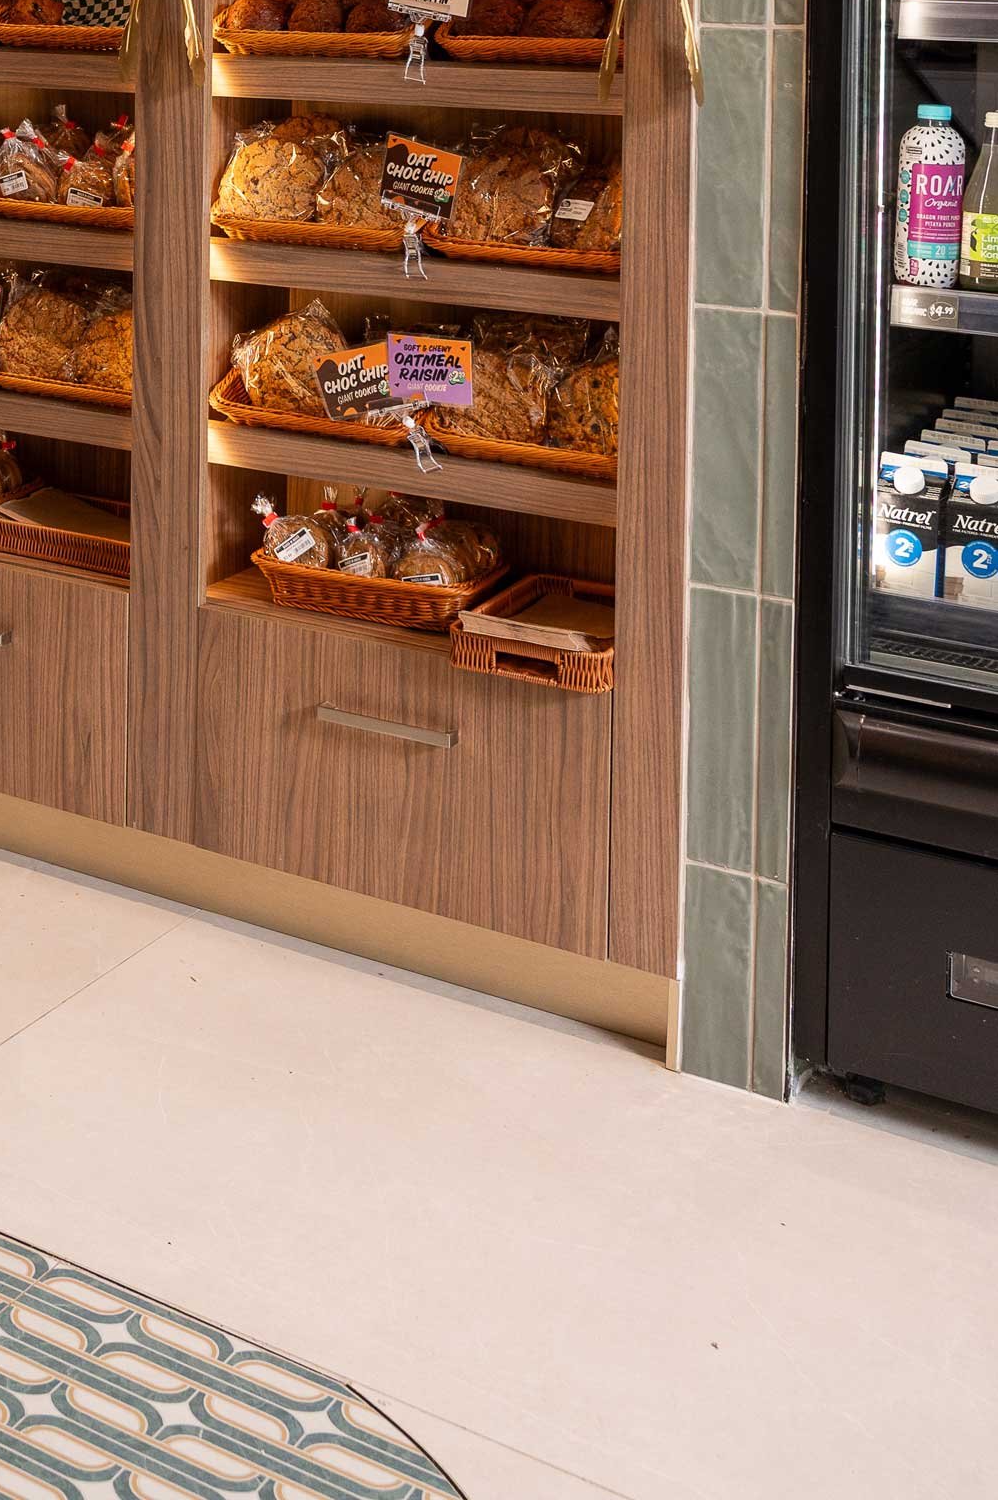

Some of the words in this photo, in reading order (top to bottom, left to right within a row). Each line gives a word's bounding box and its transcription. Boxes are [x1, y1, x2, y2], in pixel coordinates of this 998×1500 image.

[406, 153, 436, 168] OAT
[386, 162, 421, 181] CHOC
[422, 169, 454, 187] CHIP
[392, 181, 411, 191] GIANT
[410, 185, 434, 196] COOKIE
[915, 173, 962, 196] ROAR
[929, 304, 954, 317] $4.99
[403, 343, 421, 351] SOFT
[338, 353, 365, 376] OAT
[394, 353, 462, 369] OATMEAL
[324, 375, 357, 394] CHOC
[359, 364, 388, 383] CHIP
[399, 368, 449, 382] RAISIN
[337, 391, 354, 405] GIANT
[354, 384, 378, 398] COOKIE
[424, 383, 447, 392] COOKIE
[878, 503, 932, 525] Natrel
